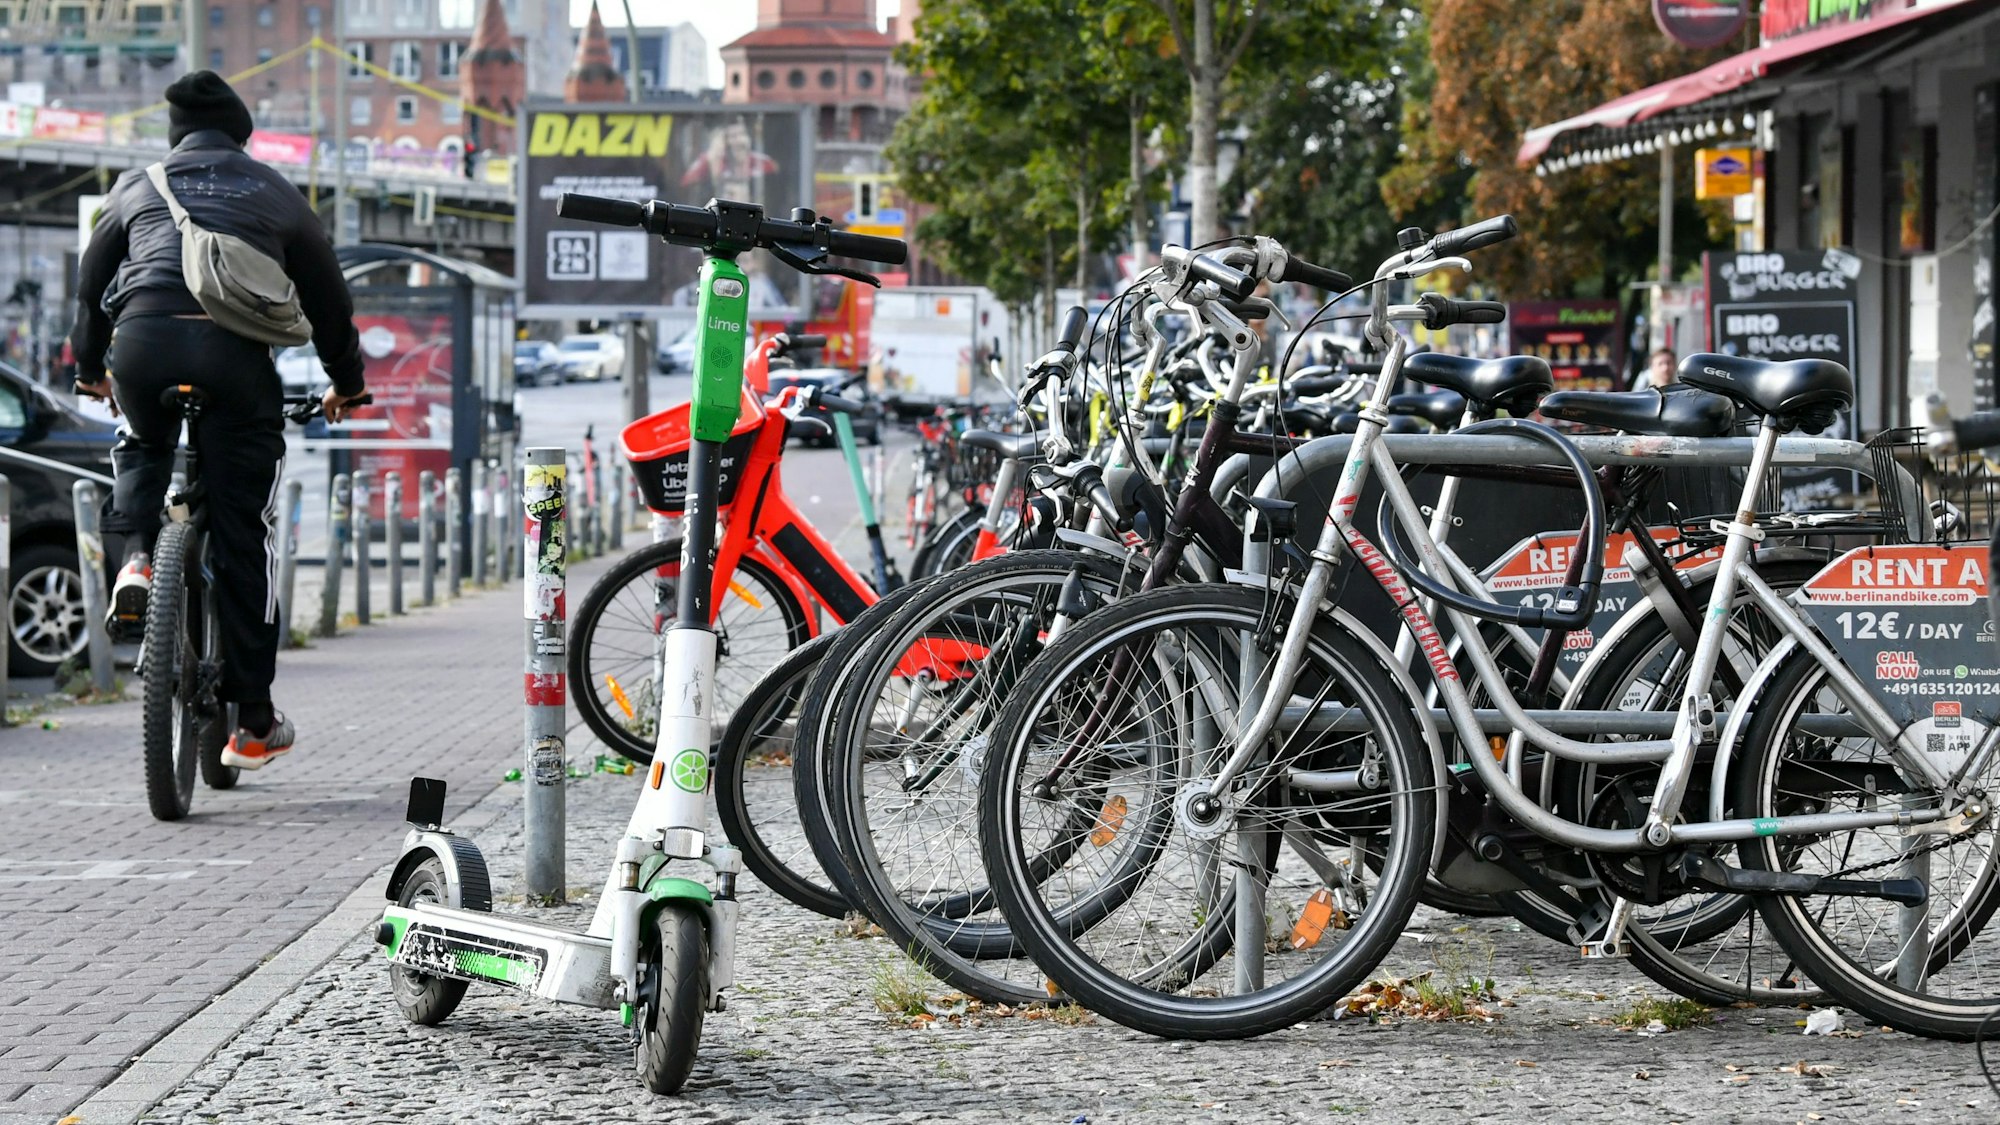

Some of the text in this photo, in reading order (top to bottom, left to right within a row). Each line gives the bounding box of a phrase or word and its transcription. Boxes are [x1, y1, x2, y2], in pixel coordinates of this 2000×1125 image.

[528, 113, 673, 157] DAZN
[557, 239, 586, 254] DA
[557, 256, 586, 273] ZN
[1736, 254, 1784, 275] BRO
[1755, 270, 1847, 291] BURGER
[708, 315, 741, 333] Lime
[1726, 314, 1780, 336] BRO
[1748, 334, 1841, 352] BURGER
[1703, 366, 1735, 381] GEL
[662, 477, 688, 489] Ube
[1851, 558, 1985, 586] RENT A
[1809, 591, 1969, 602] www.berlinandbike.com
[1835, 611, 1900, 640] 12€
[1920, 623, 1964, 640] DAY
[1877, 651, 1918, 665] CALL
[1876, 665, 2000, 679] NOW OR USE WhatsA
[1622, 699, 1641, 707] APP
